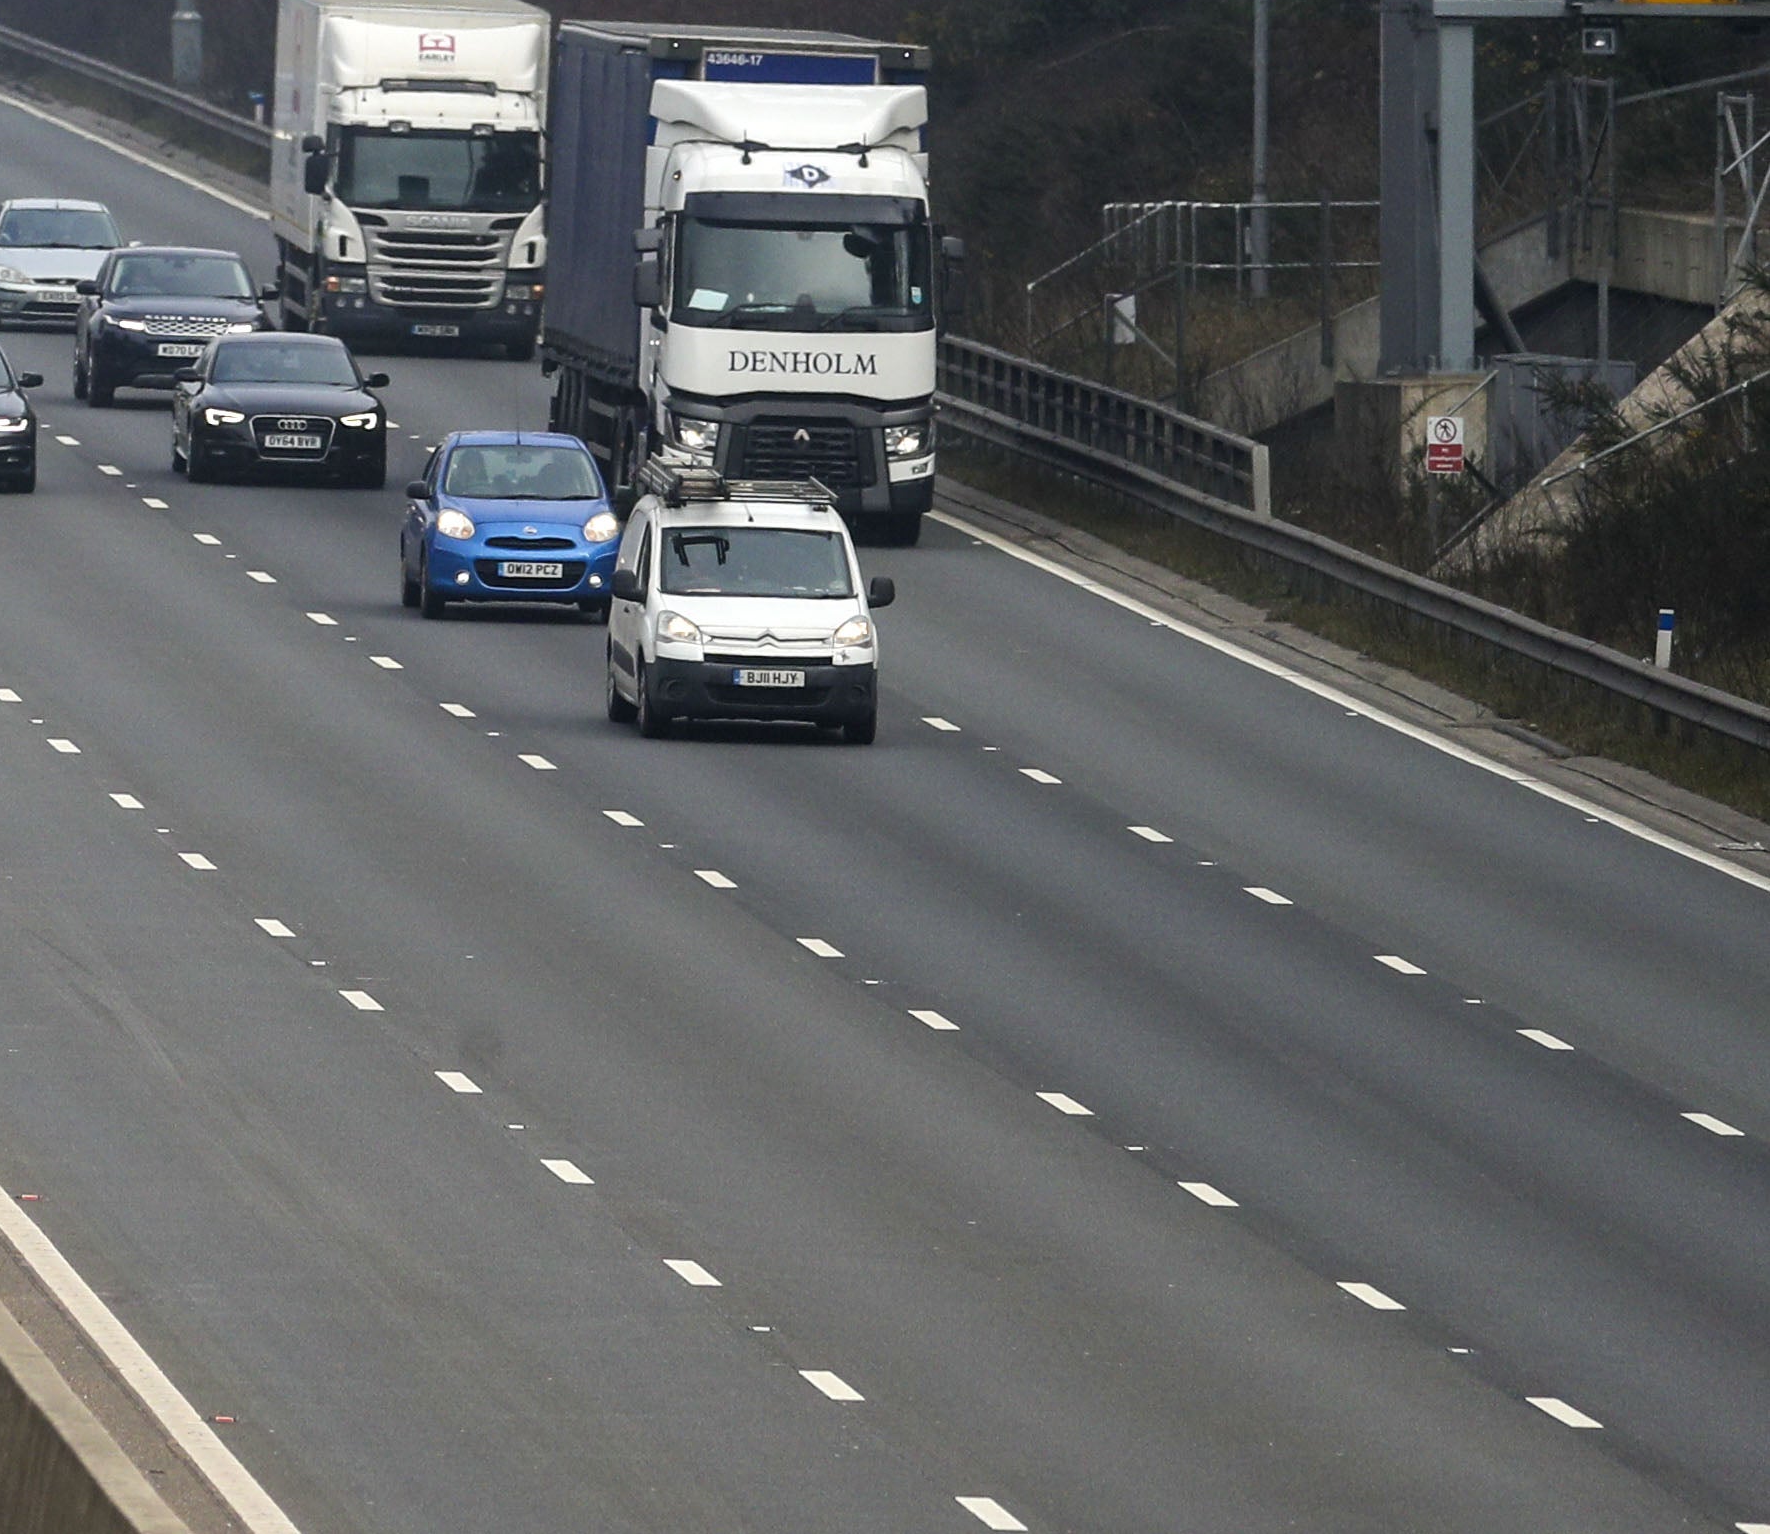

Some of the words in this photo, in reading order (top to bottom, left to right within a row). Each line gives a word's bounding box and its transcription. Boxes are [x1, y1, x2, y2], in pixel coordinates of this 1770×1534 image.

[728, 350, 878, 375] DENHOLM
[507, 563, 533, 575] OW12
[535, 564, 558, 575] PCZ
[747, 672, 770, 684] BJ11
[773, 672, 797, 684] HJY
